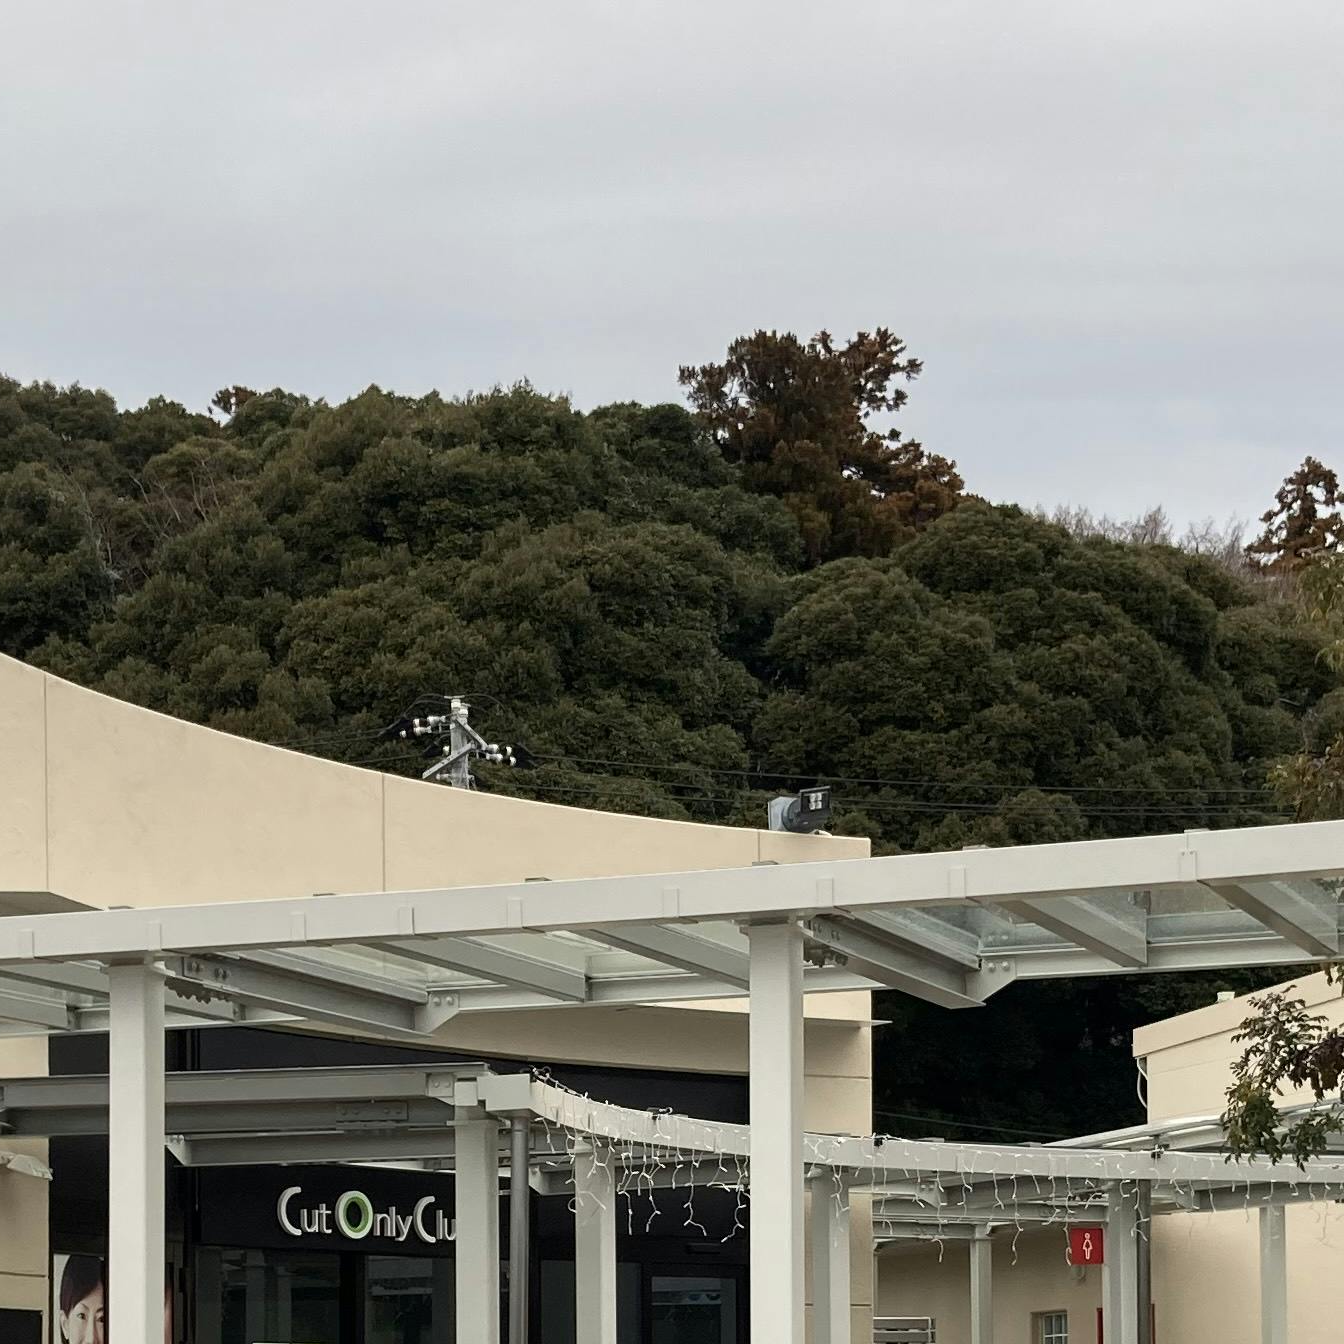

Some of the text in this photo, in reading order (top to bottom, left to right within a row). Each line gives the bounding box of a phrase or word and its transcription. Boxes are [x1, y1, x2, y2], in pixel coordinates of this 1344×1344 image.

[277, 1186, 456, 1243] Cut Only Clu
